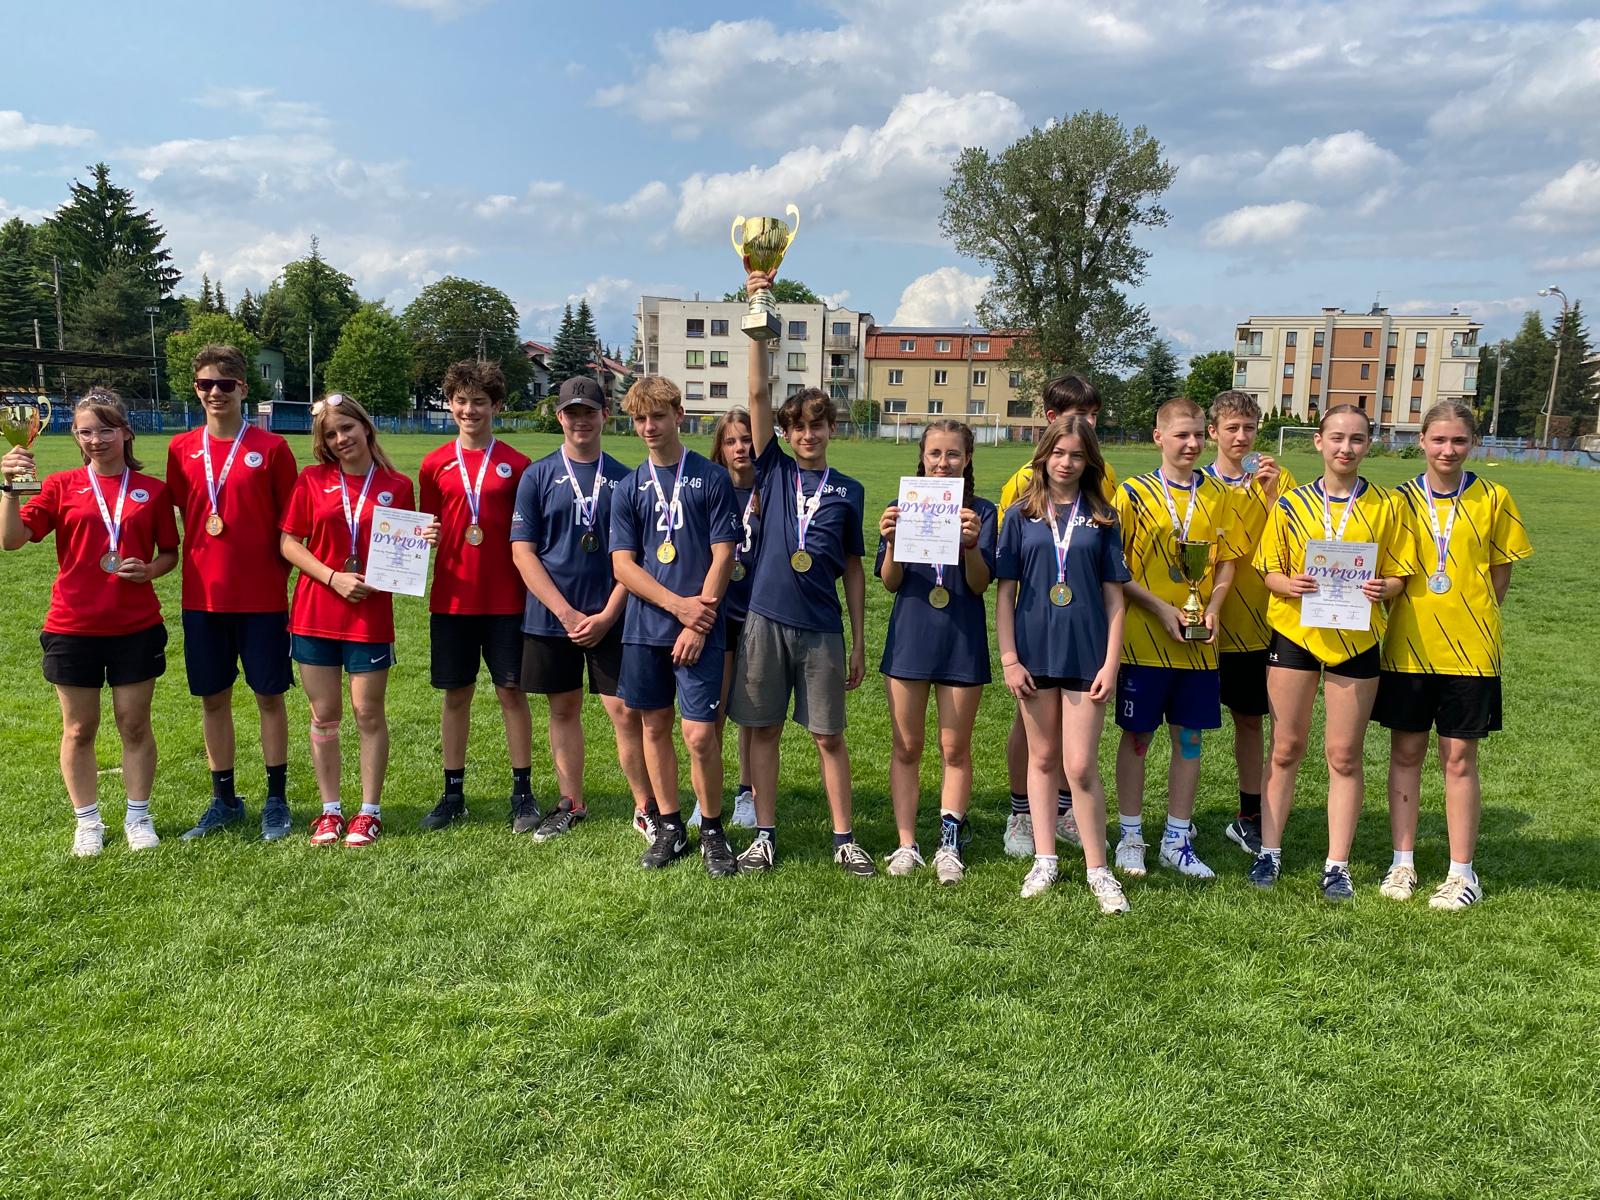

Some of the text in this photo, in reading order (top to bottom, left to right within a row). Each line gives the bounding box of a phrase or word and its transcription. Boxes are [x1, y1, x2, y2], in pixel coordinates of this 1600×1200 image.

[690, 477, 702, 488] 46
[836, 486, 847, 498] 46
[655, 500, 683, 532] 20
[899, 502, 959, 516] DYPLOM
[373, 533, 428, 550] DYPLOM
[1307, 566, 1371, 582] DYPLOM
[1124, 700, 1133, 717] 23
